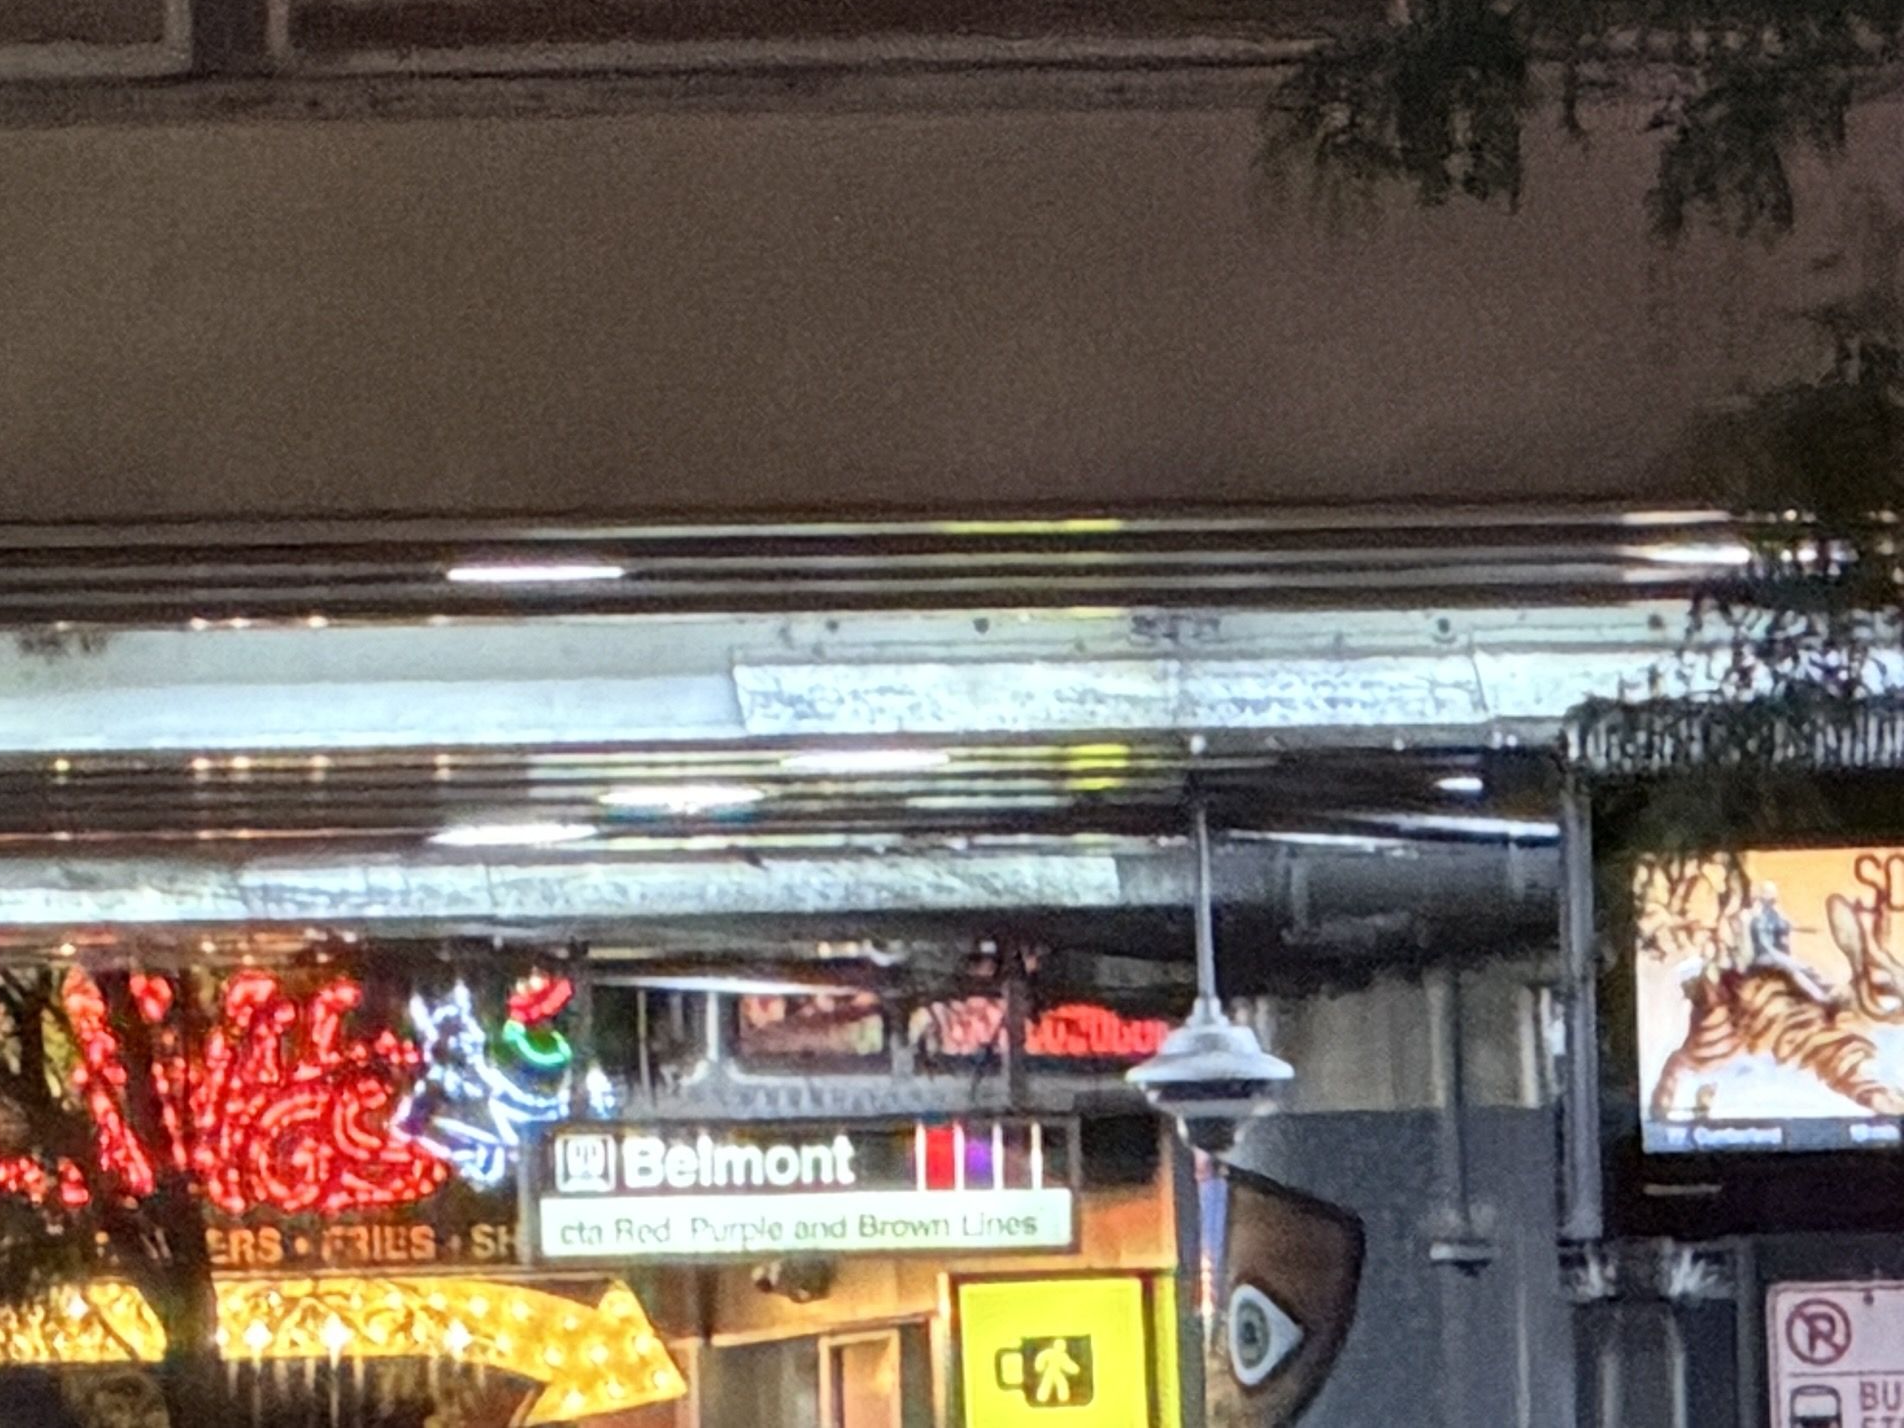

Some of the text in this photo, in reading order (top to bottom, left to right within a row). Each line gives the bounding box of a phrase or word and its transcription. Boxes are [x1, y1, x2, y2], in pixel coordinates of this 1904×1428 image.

[622, 1134, 857, 1188] Belmont
[321, 1223, 438, 1261] FRIES
[794, 1215, 847, 1241] and
[858, 1213, 951, 1240] Brown
[962, 1211, 1039, 1238] Lines
